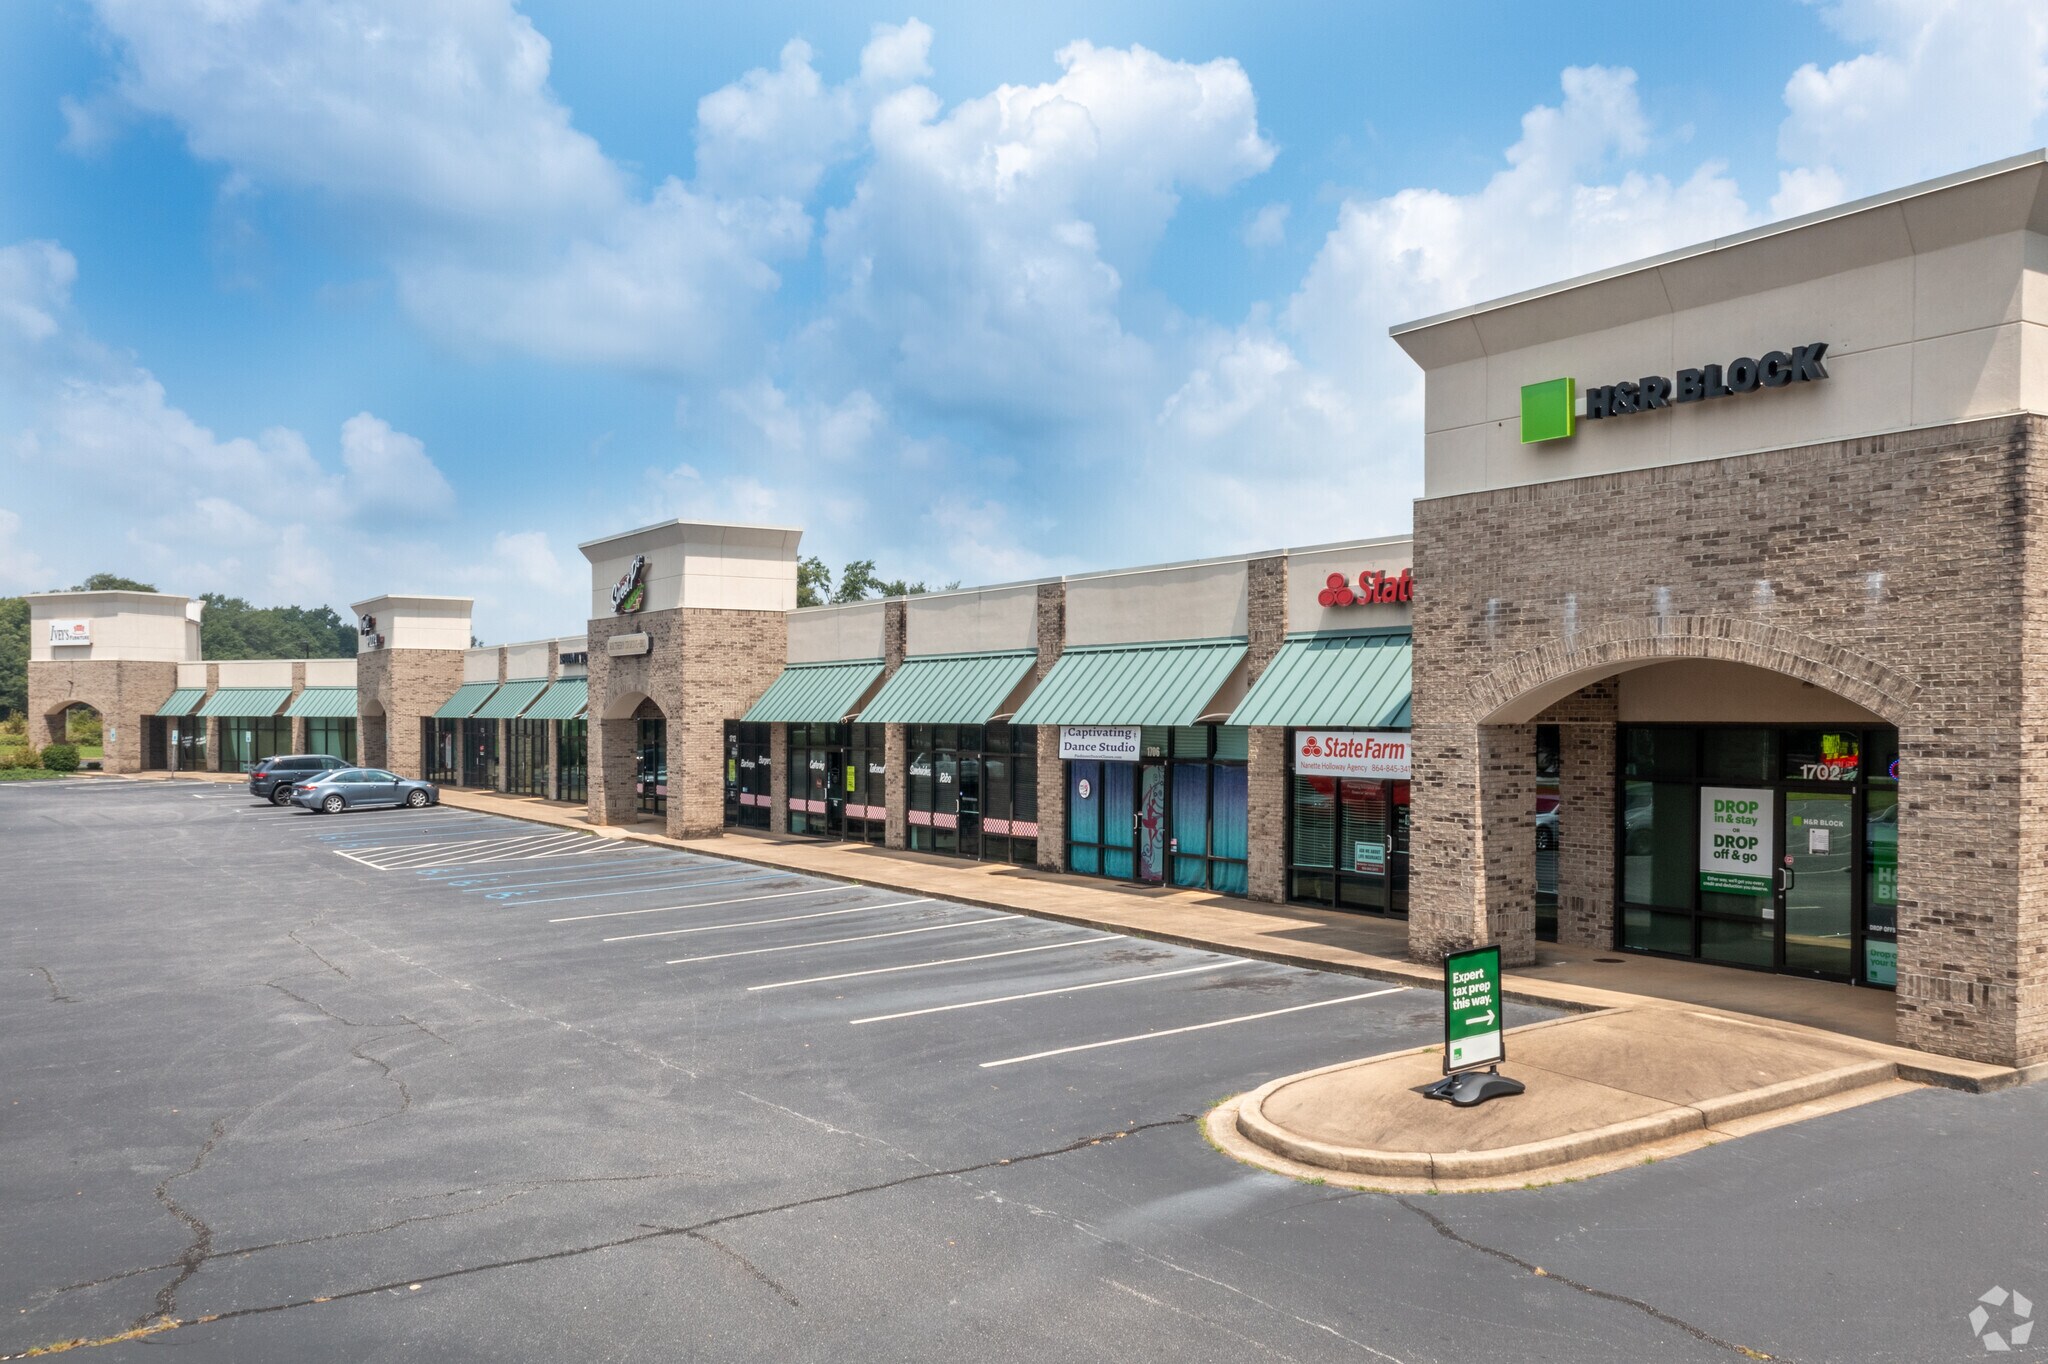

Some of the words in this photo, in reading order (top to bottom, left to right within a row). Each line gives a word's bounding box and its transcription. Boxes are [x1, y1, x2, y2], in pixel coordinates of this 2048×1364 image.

[1587, 376, 1672, 420] H&R
[1676, 341, 1830, 404] BLOCK
[1068, 727, 1131, 739] Captivating
[1064, 742, 1096, 751] Dance
[1099, 743, 1135, 752] Studio
[1147, 747, 1160, 757] 1706
[1324, 736, 1364, 758] State
[1364, 737, 1405, 760] Farm
[809, 759, 826, 772] Catering
[1301, 761, 1321, 770] Nanette
[1321, 762, 1346, 773] Holloway
[1346, 764, 1368, 773] Agency
[1800, 764, 1841, 780] 1702
[1713, 799, 1759, 815] DROP
[1714, 813, 1724, 823] in
[1725, 814, 1734, 824] &
[1735, 815, 1758, 827] stay
[1803, 818, 1819, 826] H&R
[1819, 819, 1844, 828] BLOCK
[1713, 834, 1759, 850] DROP
[1713, 849, 1729, 860] off
[1731, 850, 1741, 861] &
[1742, 852, 1758, 864] go
[1869, 924, 1883, 932] DROP
[1870, 949, 1891, 960] Drop
[1870, 959, 1889, 967] your
[1453, 969, 1483, 983] Expert
[1453, 985, 1467, 997] tax
[1469, 982, 1490, 995] prep
[1453, 997, 1470, 1010] this
[1471, 994, 1492, 1007] way.
